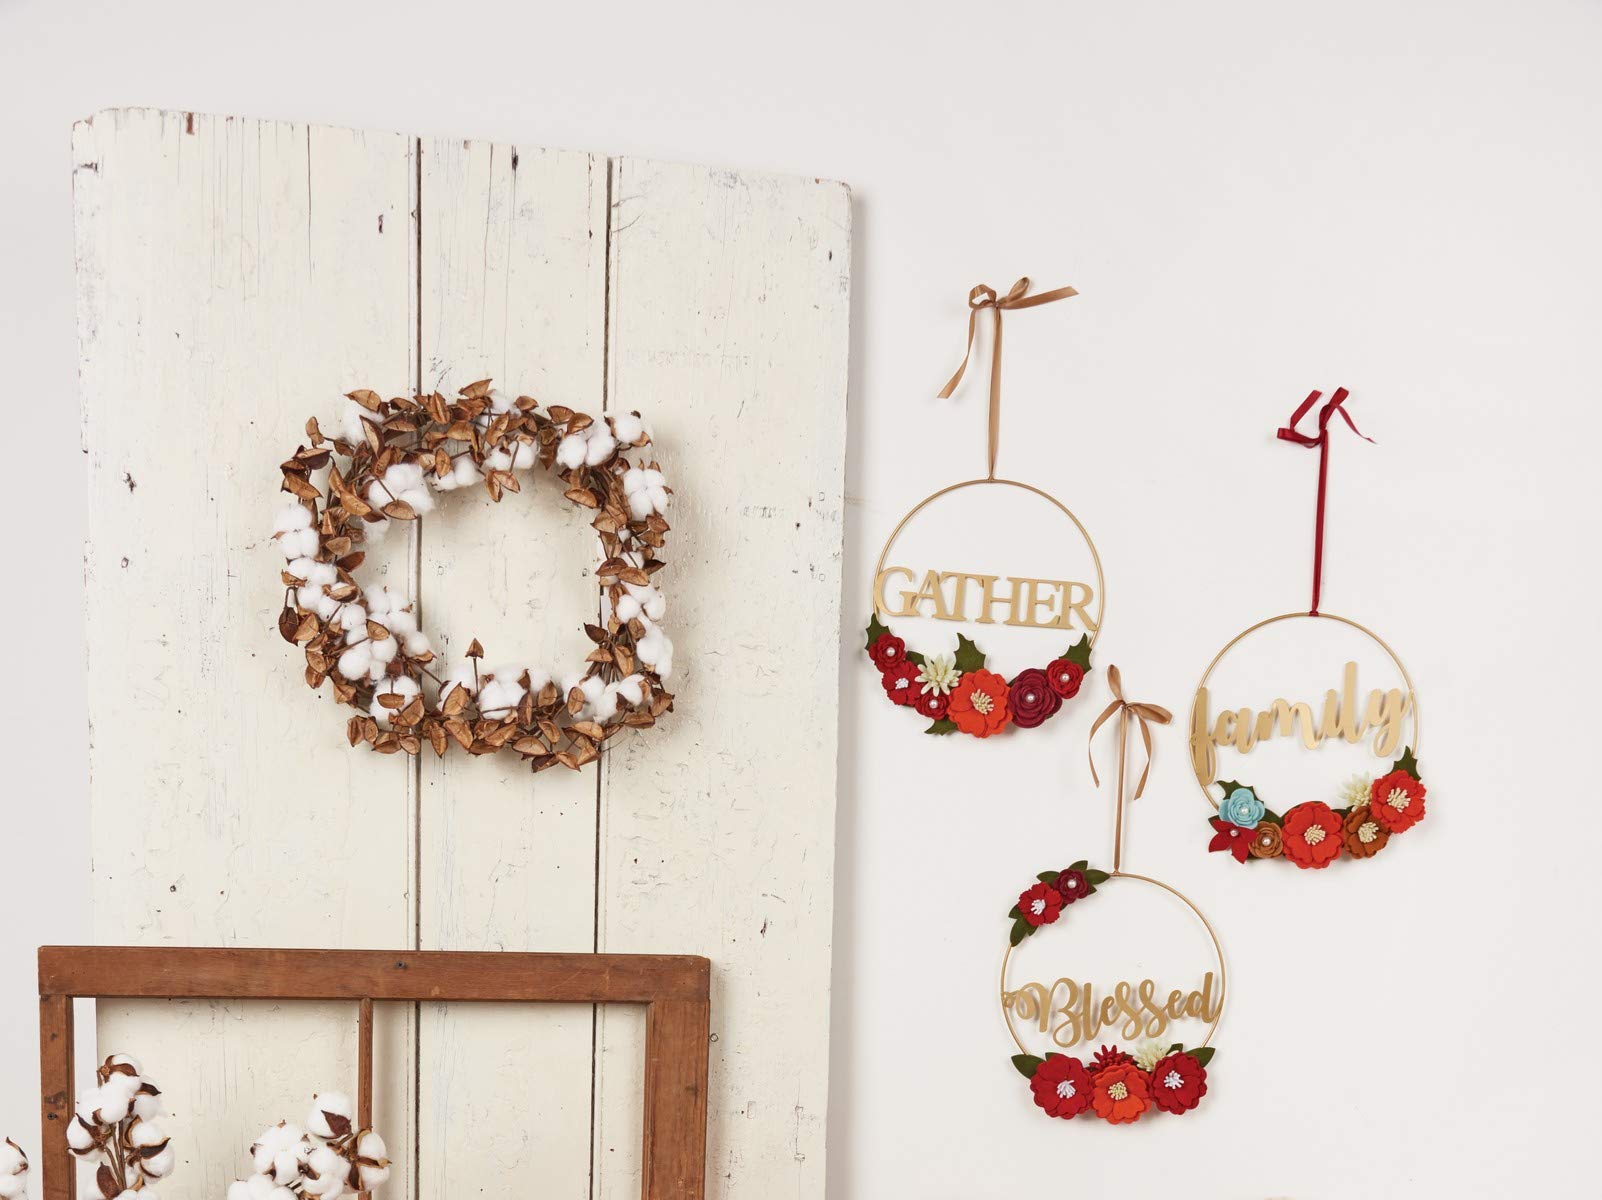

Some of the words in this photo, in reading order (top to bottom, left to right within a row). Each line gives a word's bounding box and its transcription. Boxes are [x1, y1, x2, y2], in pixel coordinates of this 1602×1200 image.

[874, 566, 1098, 631] GATHER
[1190, 661, 1414, 786] family
[1002, 972, 1224, 1048] Blessed
